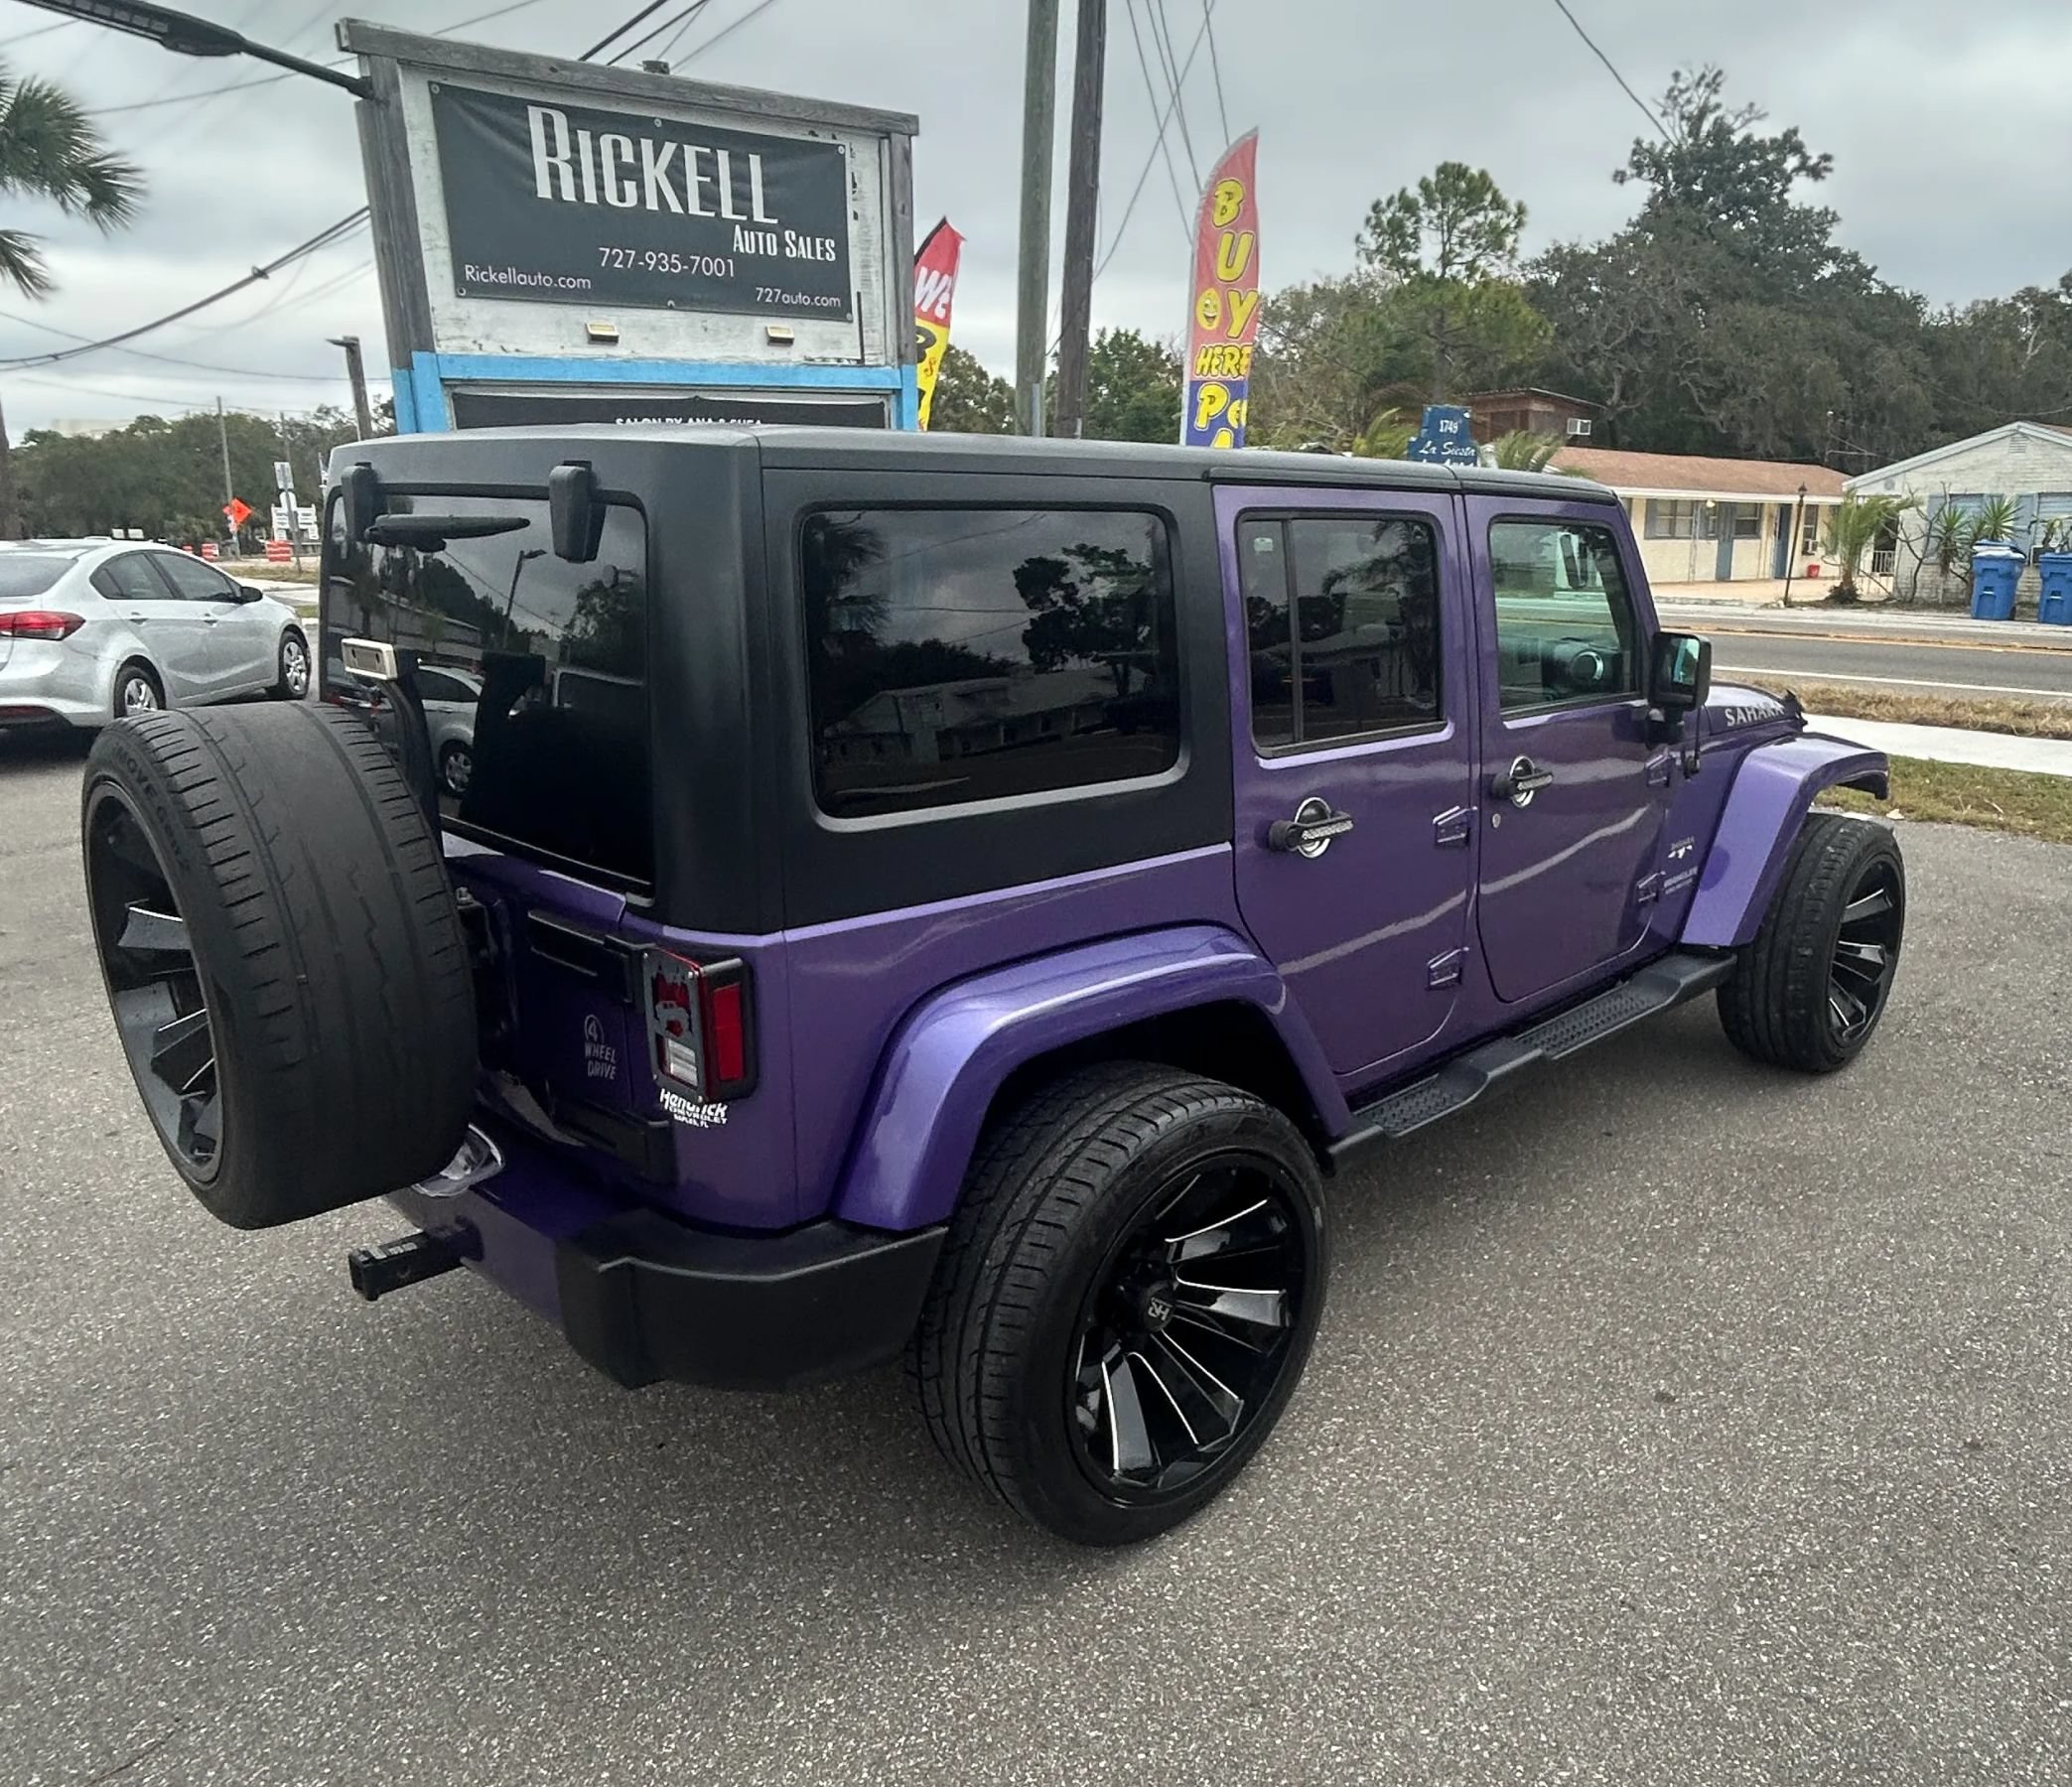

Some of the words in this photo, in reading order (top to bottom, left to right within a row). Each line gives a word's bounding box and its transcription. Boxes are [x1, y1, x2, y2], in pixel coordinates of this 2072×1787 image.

[527, 105, 779, 224] RICKELL
[733, 224, 778, 257] AUTO
[783, 229, 837, 262] SALES
[598, 246, 736, 278] 727-935-7001
[464, 264, 593, 291] Rickellauto.com
[755, 287, 842, 308] 727auto.com
[1419, 440, 1438, 456] La
[1725, 701, 1785, 727] SAHARA
[584, 1039, 617, 1065] WHEEL
[587, 1059, 618, 1081] DRIVE
